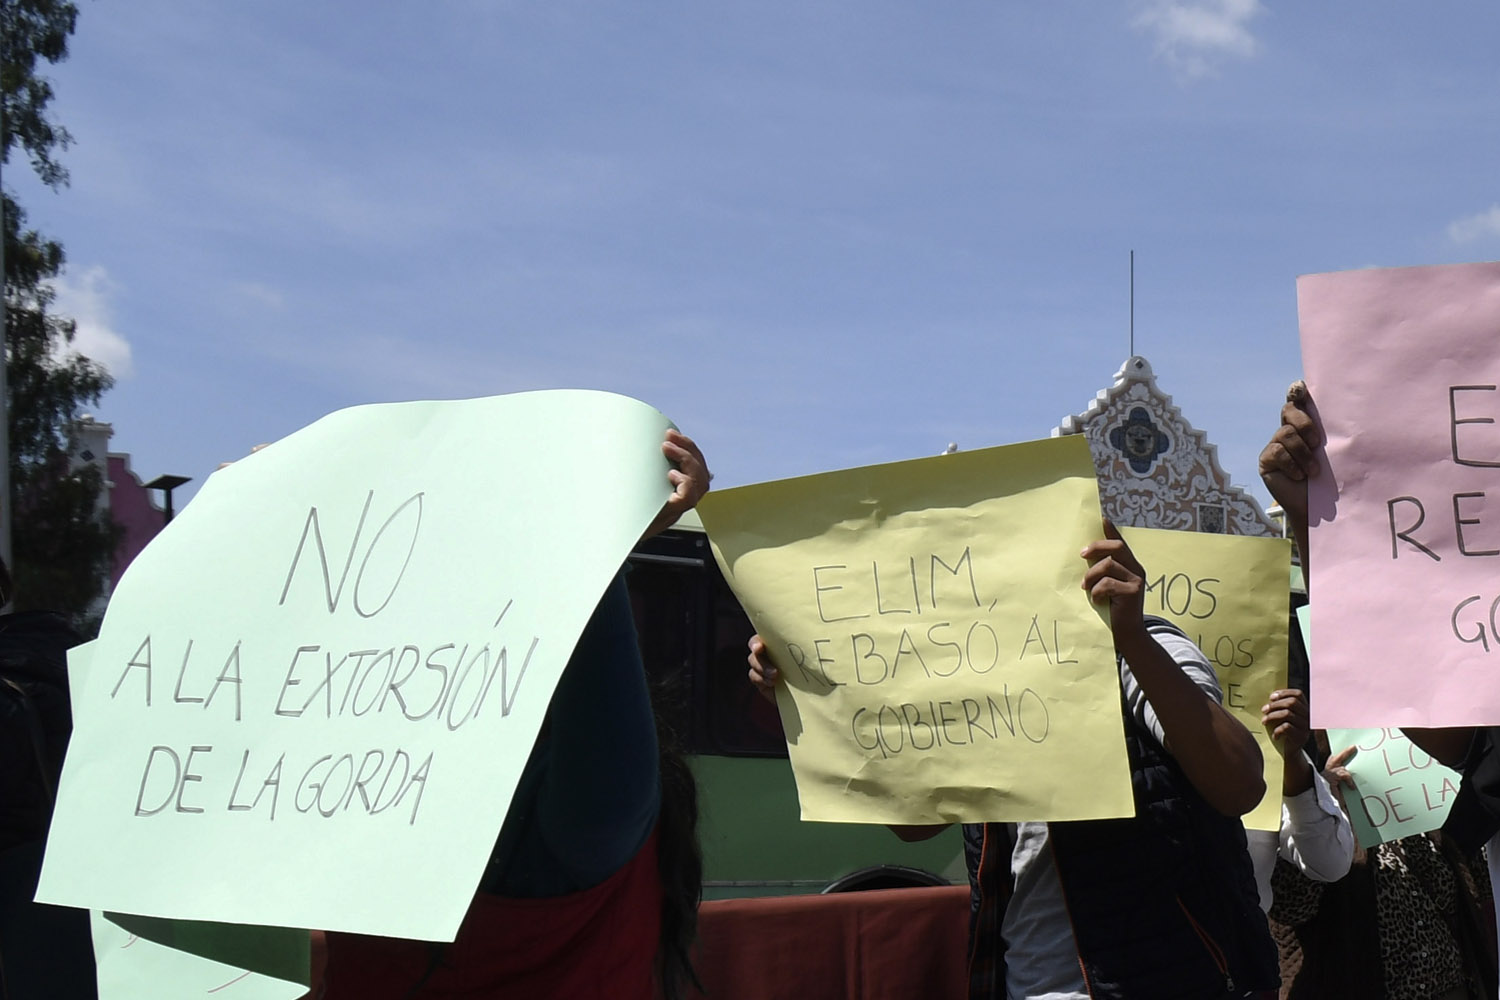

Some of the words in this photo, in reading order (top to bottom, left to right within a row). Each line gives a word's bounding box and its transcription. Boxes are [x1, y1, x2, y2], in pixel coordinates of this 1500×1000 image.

[279, 490, 425, 619] NO
[813, 546, 984, 623] ELIM
[111, 635, 152, 706] A
[174, 639, 242, 721] LA
[275, 600, 539, 731] EXTORSIÓN
[1020, 614, 1079, 666] AL
[852, 683, 1049, 760] GOBIERNO
[135, 746, 212, 818] DE
[228, 749, 286, 821] LA
[294, 749, 434, 825] GORDA
[1360, 787, 1417, 828] DE
